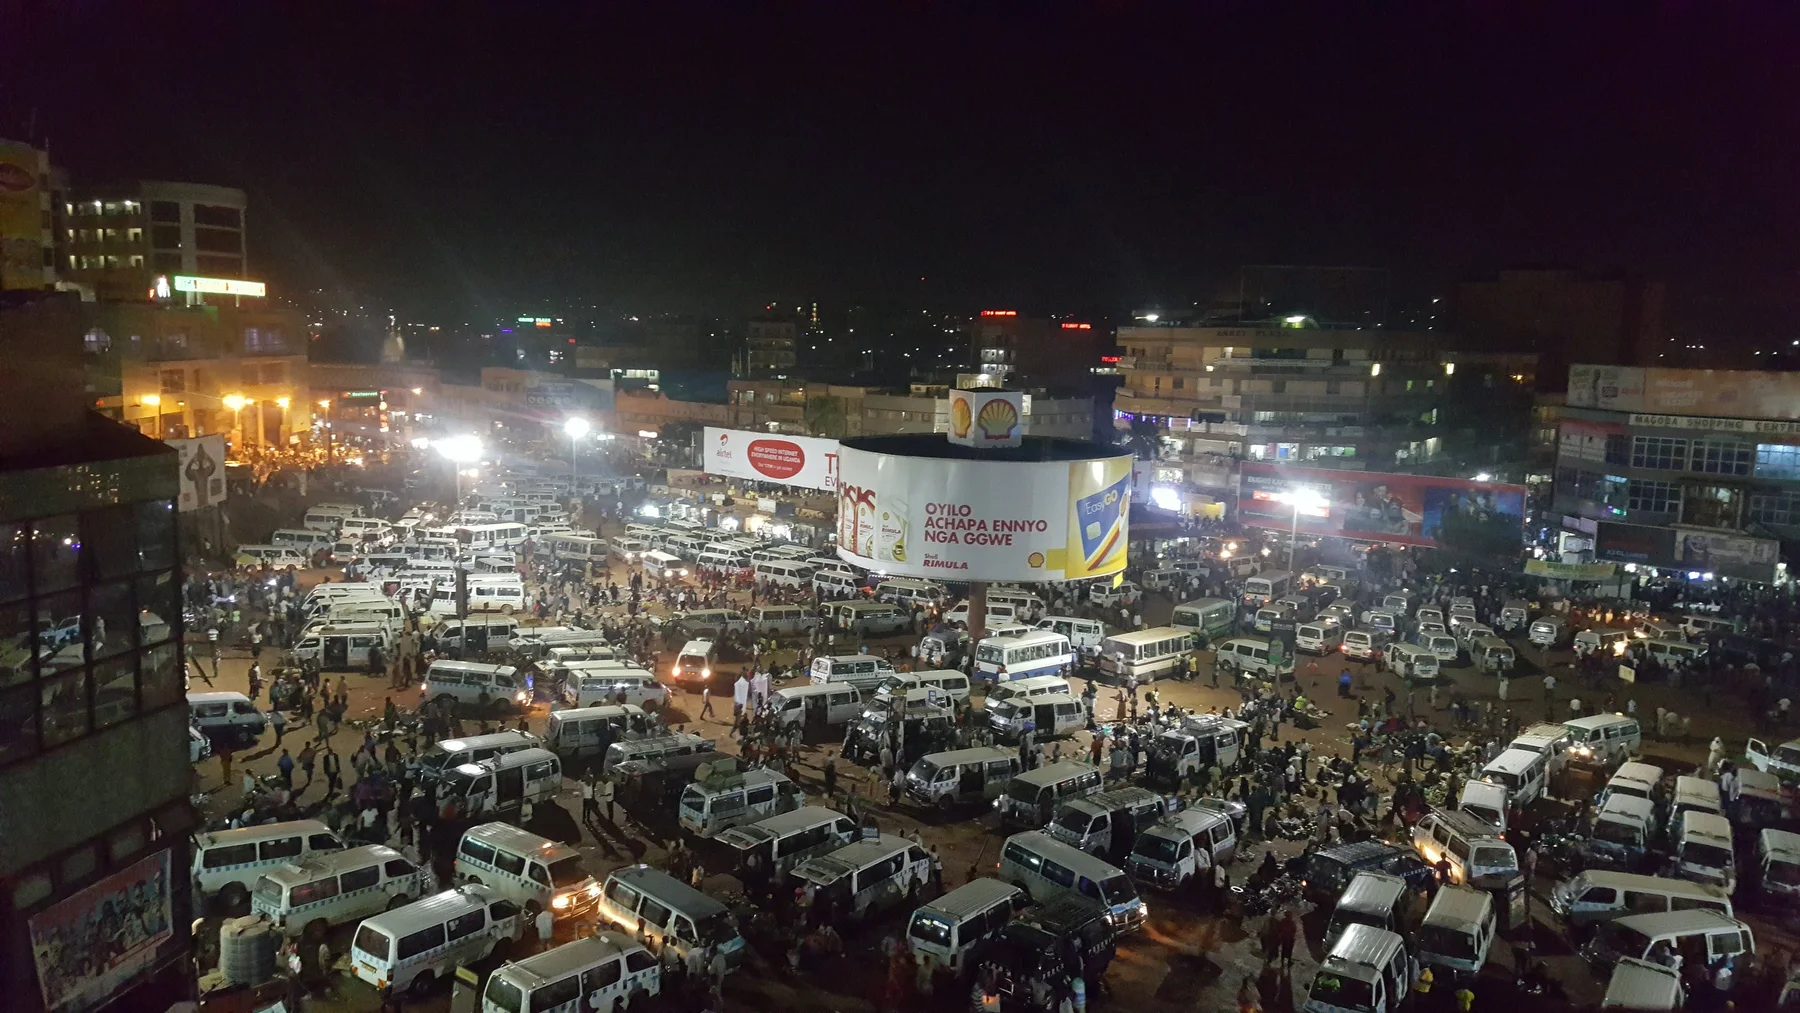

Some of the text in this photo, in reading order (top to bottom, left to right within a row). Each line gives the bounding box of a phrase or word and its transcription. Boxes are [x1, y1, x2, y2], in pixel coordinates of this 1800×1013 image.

[716, 448, 732, 459] airtel
[925, 502, 971, 517] OYILO
[1085, 489, 1118, 515] EasyGO
[924, 516, 1048, 532] ACHAPA ENNYO
[924, 530, 1013, 546] NGA GGWE
[923, 559, 969, 570] RIMULA
